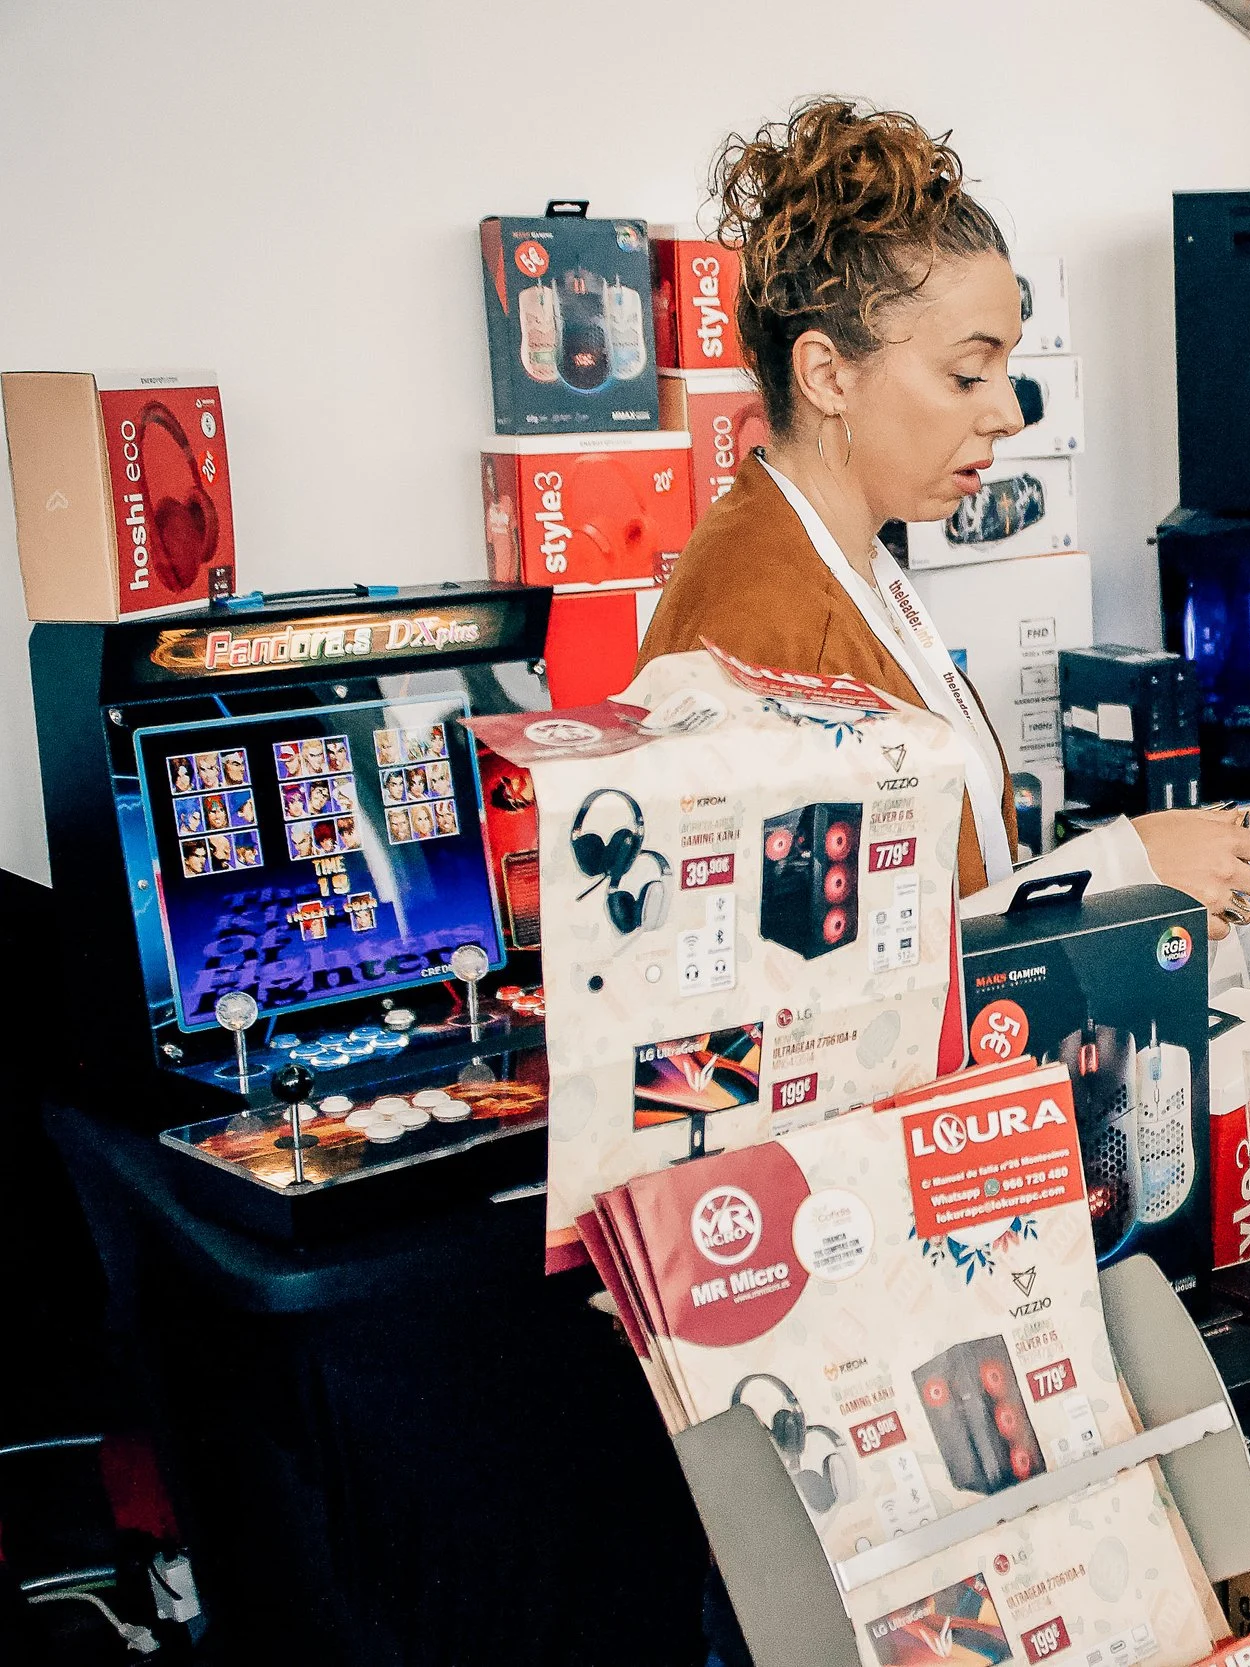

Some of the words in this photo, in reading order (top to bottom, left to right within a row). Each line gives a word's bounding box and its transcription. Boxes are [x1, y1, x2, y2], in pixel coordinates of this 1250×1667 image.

[691, 256, 729, 359] style3
[120, 420, 141, 482] eco
[712, 415, 735, 469] eco
[533, 470, 573, 573] style3
[124, 493, 149, 591] hoshi
[697, 796, 726, 807] KROM
[877, 777, 919, 790] VIZZIO
[311, 856, 346, 876] TIME
[1161, 940, 1188, 954] RGB
[976, 973, 1007, 987] MARS
[1009, 966, 1046, 981] GAMING
[980, 1011, 1021, 1058] 5€
[779, 1078, 811, 1107] 199€
[691, 1278, 729, 1308] MR
[730, 1262, 789, 1295] Micro
[1009, 1298, 1051, 1319] VIZZIO
